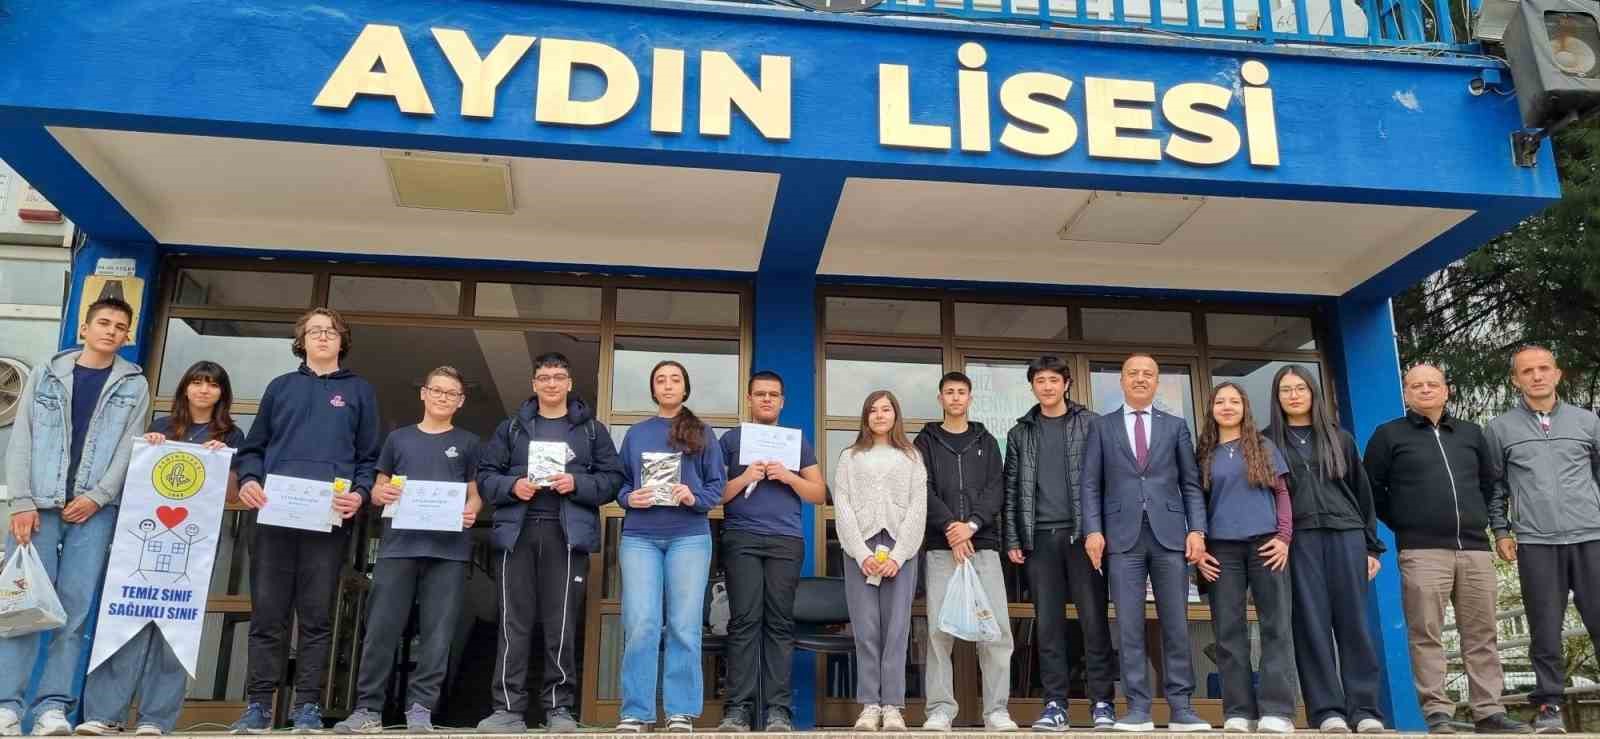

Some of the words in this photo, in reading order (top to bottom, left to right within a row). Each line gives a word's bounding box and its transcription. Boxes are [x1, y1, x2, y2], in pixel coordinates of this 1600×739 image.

[312, 24, 792, 140] AYDIN
[879, 42, 1280, 166] LİSESİ
[121, 585, 159, 600] TEMİZ
[161, 588, 192, 602] SINIF
[108, 602, 165, 618] SAĞLIKLI
[167, 607, 198, 620] SINIF
